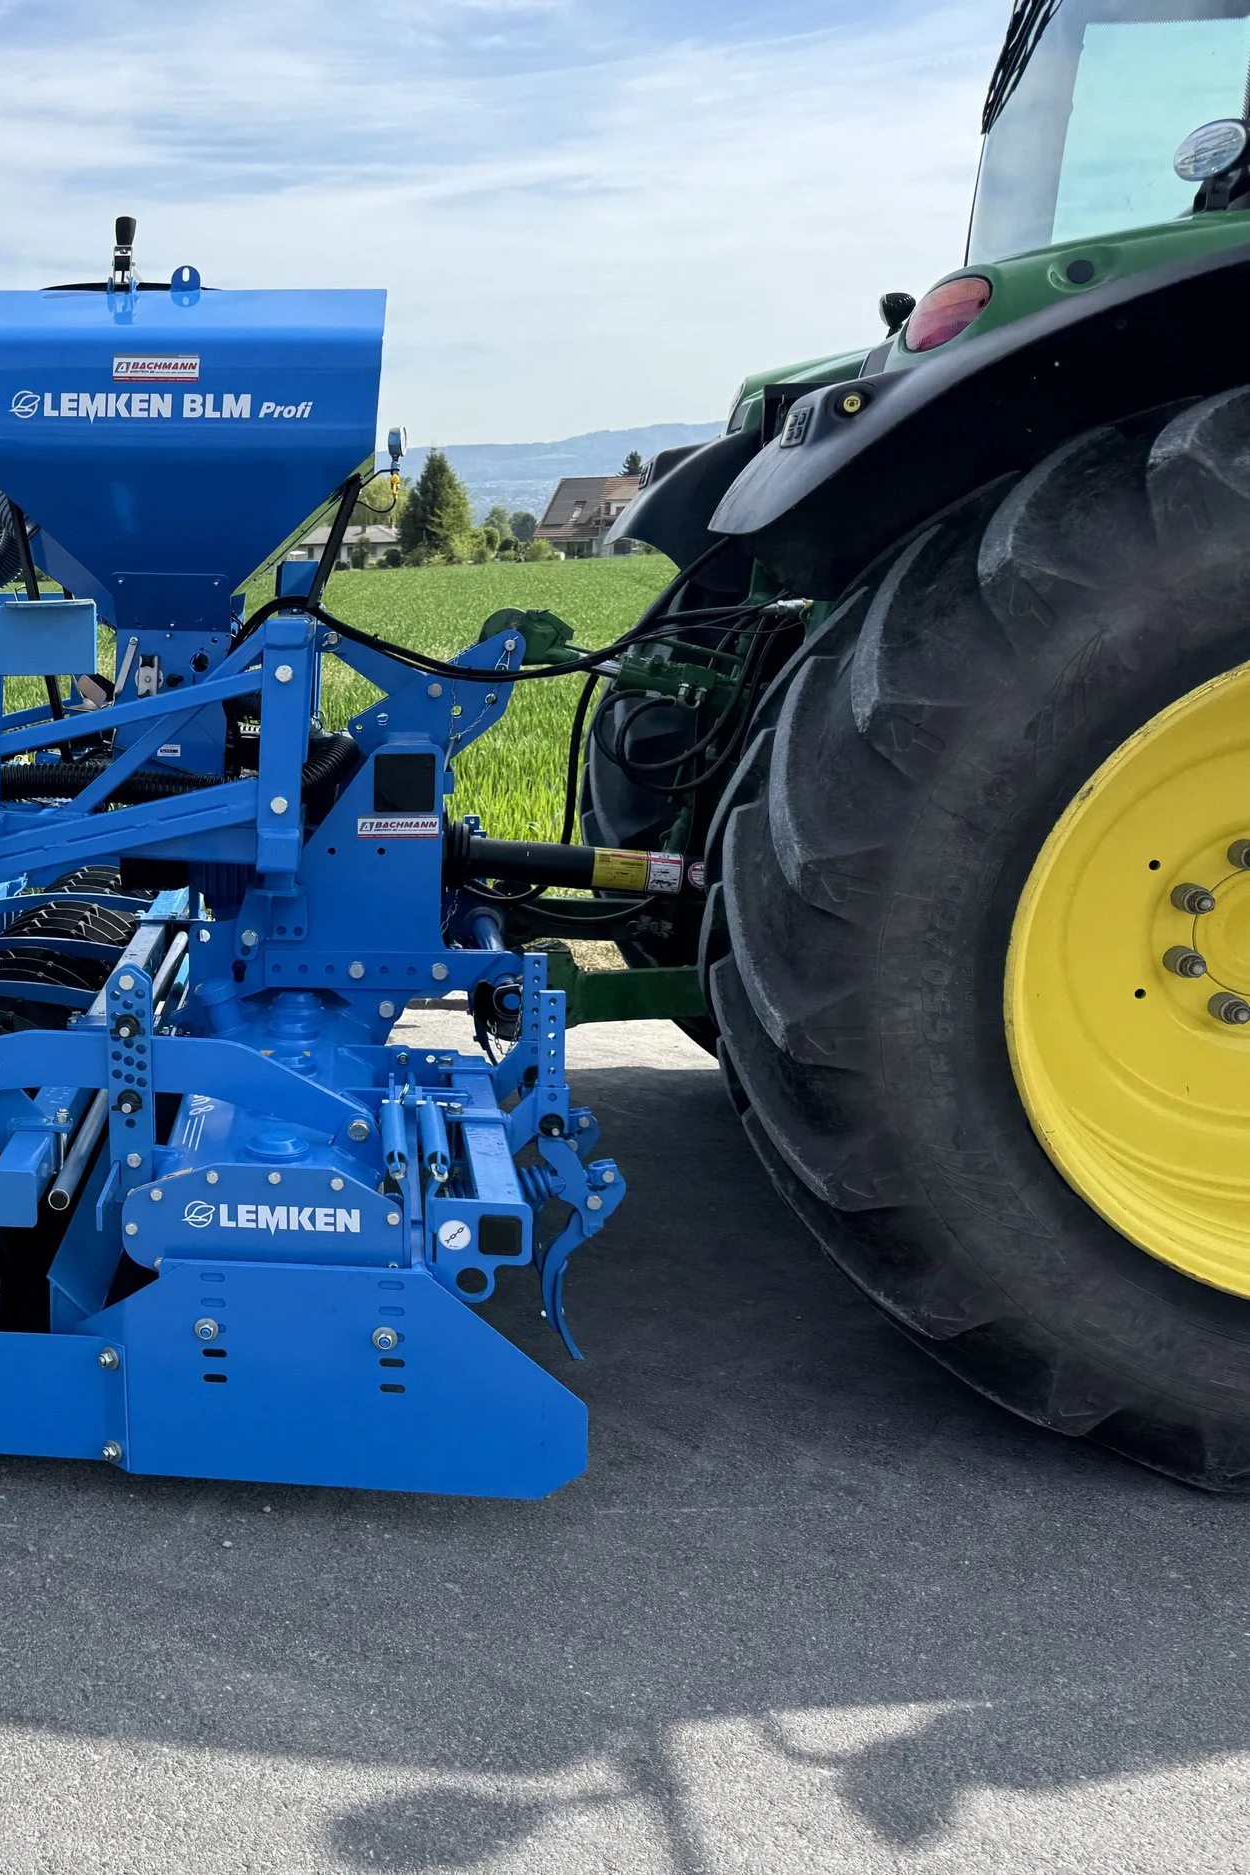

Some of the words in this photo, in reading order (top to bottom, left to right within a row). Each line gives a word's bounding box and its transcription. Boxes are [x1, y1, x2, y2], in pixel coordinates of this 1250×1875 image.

[131, 361, 198, 370] BACHMANN
[43, 392, 173, 424] LEMKEN
[182, 393, 252, 418] BLM
[258, 401, 314, 418] Profi
[219, 1203, 361, 1236] LEMKEN
